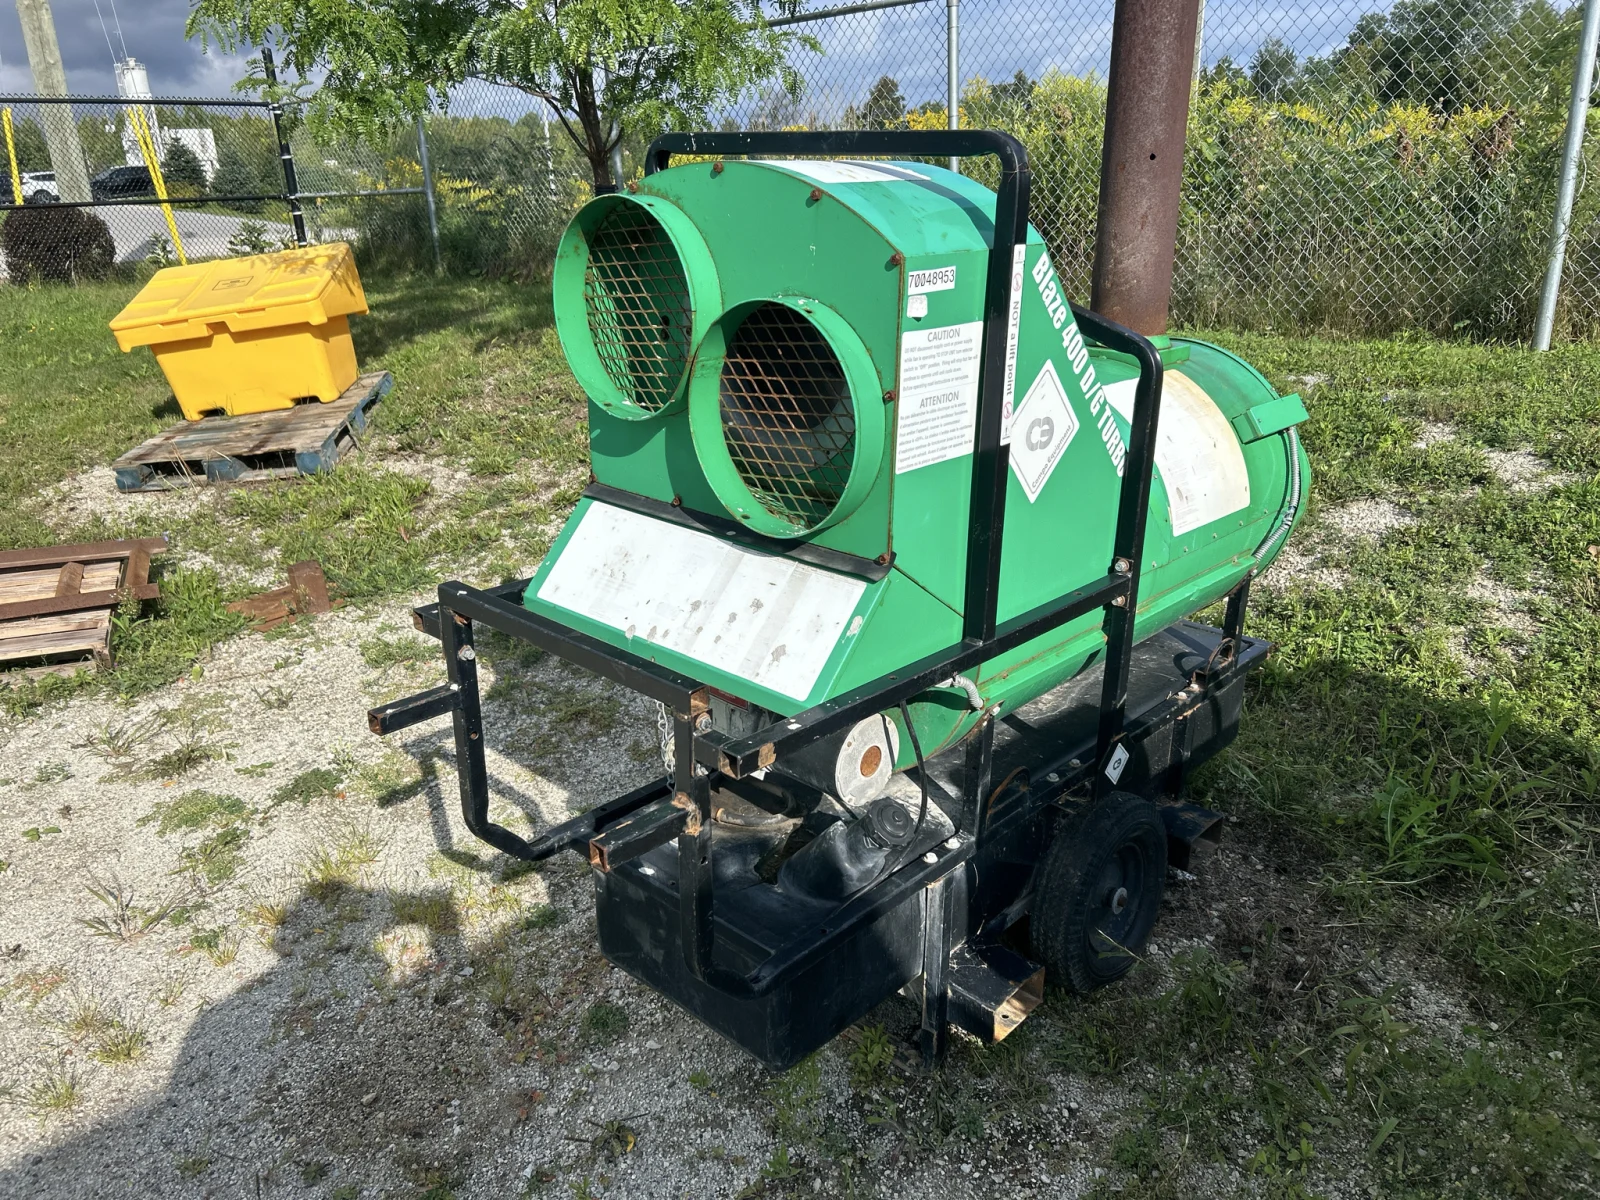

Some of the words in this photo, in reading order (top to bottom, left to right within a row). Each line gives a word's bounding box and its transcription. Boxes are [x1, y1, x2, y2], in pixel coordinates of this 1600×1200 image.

[909, 269, 954, 288] 70048953
[1012, 301, 1020, 328] NOT
[927, 328, 960, 342] CAUTION
[1032, 251, 1067, 329] Blaze
[1062, 321, 1088, 375] 400
[1080, 364, 1105, 417] D/G
[919, 390, 960, 409] ATTENTION
[1032, 463, 1049, 488] Compo
[1047, 425, 1072, 463] Equipment
